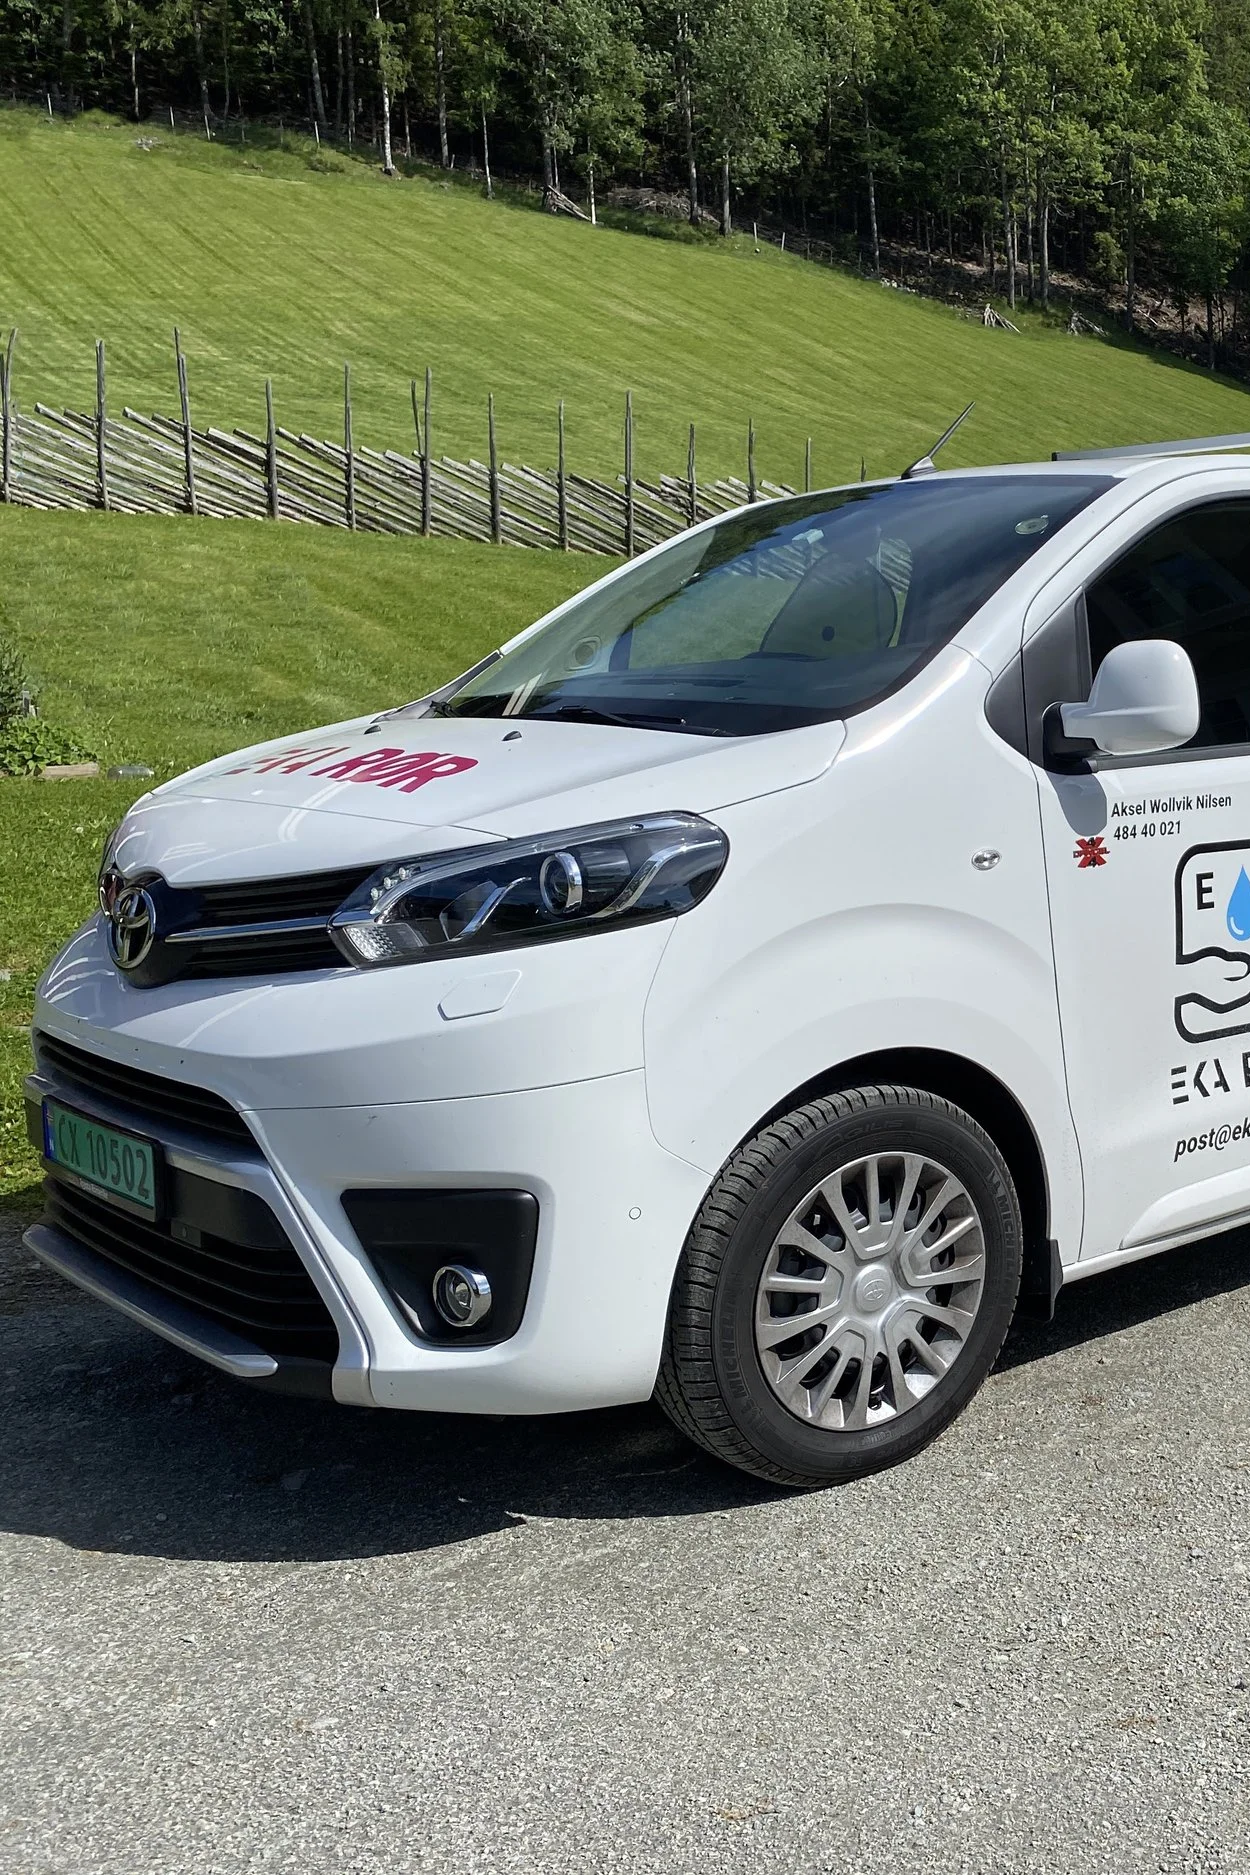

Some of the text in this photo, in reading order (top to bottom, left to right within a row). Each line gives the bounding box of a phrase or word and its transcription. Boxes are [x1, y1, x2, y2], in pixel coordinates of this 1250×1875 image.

[308, 748, 479, 793] RØR
[1111, 795, 1232, 818] Aksel Wollvik Nilsen
[1113, 820, 1182, 840] 484 40 021
[1196, 871, 1215, 910] E
[1171, 1058, 1231, 1105] EKA
[58, 1115, 150, 1200] CX 10502
